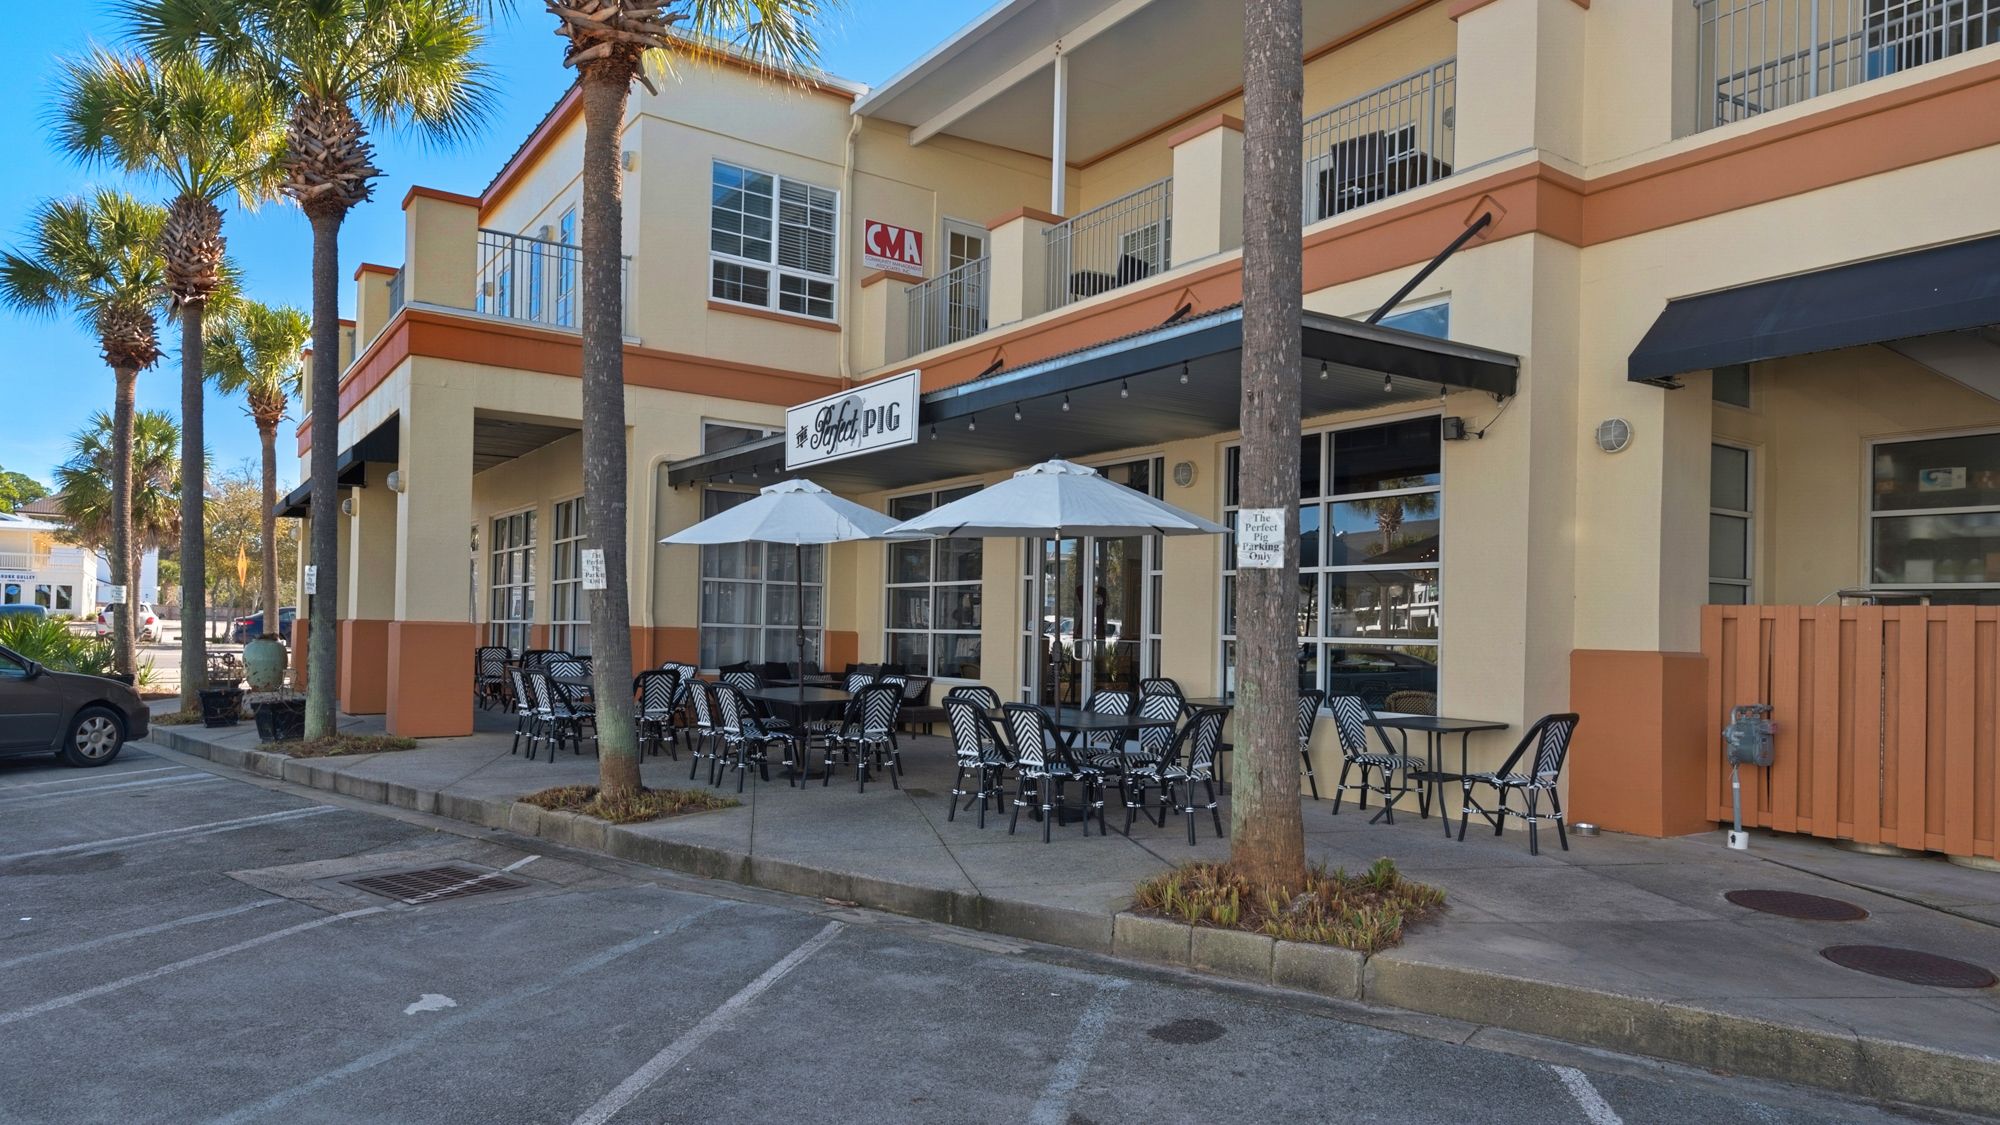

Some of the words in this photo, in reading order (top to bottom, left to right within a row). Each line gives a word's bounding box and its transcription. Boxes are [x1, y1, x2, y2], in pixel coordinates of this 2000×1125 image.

[867, 223, 921, 264] CMA
[810, 400, 859, 455] Perfect
[862, 402, 900, 438] PIG
[1253, 513, 1271, 522] The
[1245, 523, 1278, 532] Perfect
[1254, 533, 1269, 542] Pig
[1242, 542, 1280, 552] Parking
[1249, 552, 1272, 563] Only
